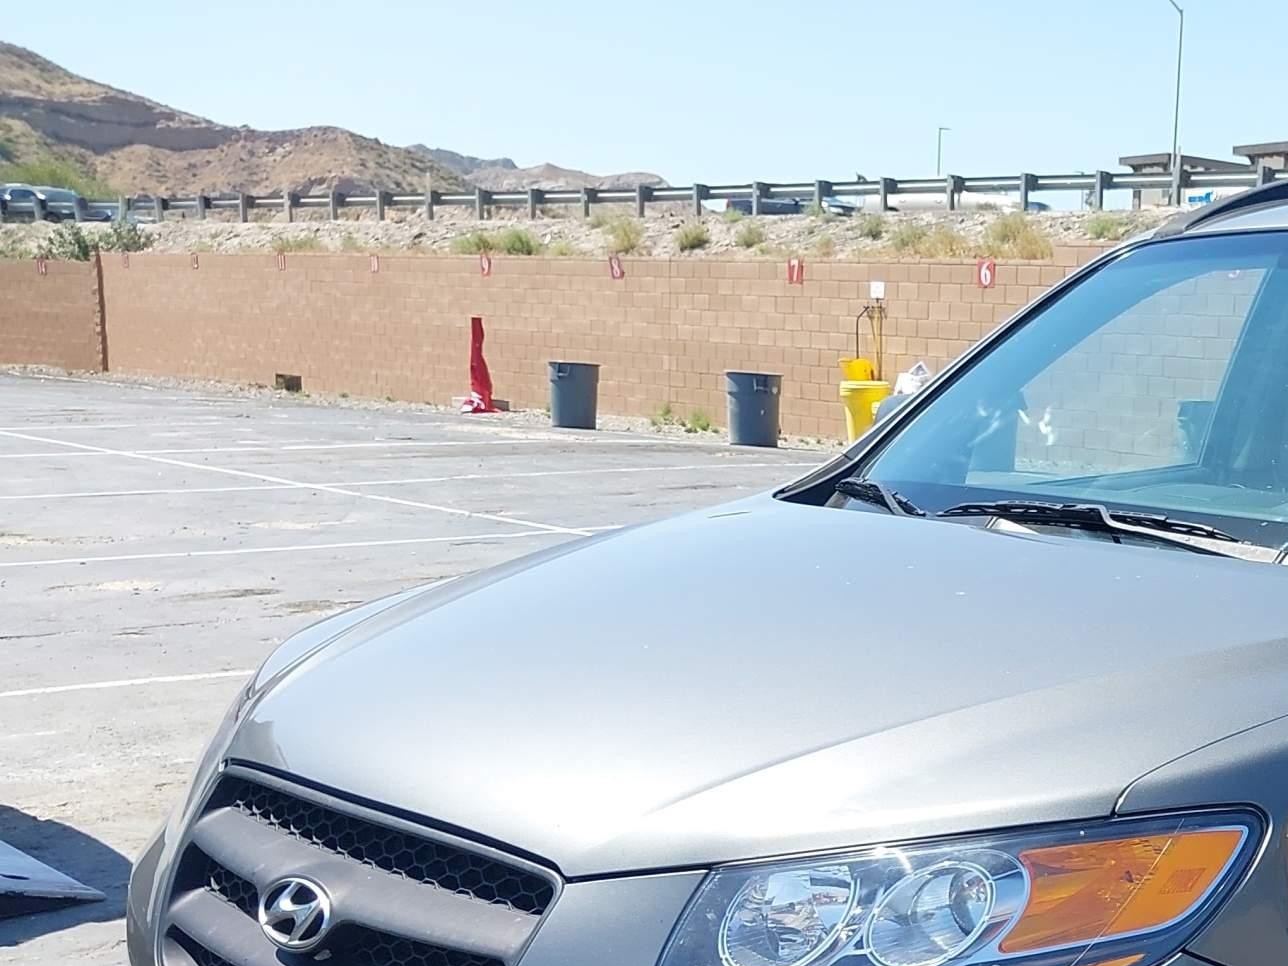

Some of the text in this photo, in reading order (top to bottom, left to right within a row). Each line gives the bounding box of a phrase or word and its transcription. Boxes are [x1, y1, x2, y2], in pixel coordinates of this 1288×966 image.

[611, 260, 620, 277] 8
[791, 260, 798, 281] 7
[980, 261, 990, 286] 6
